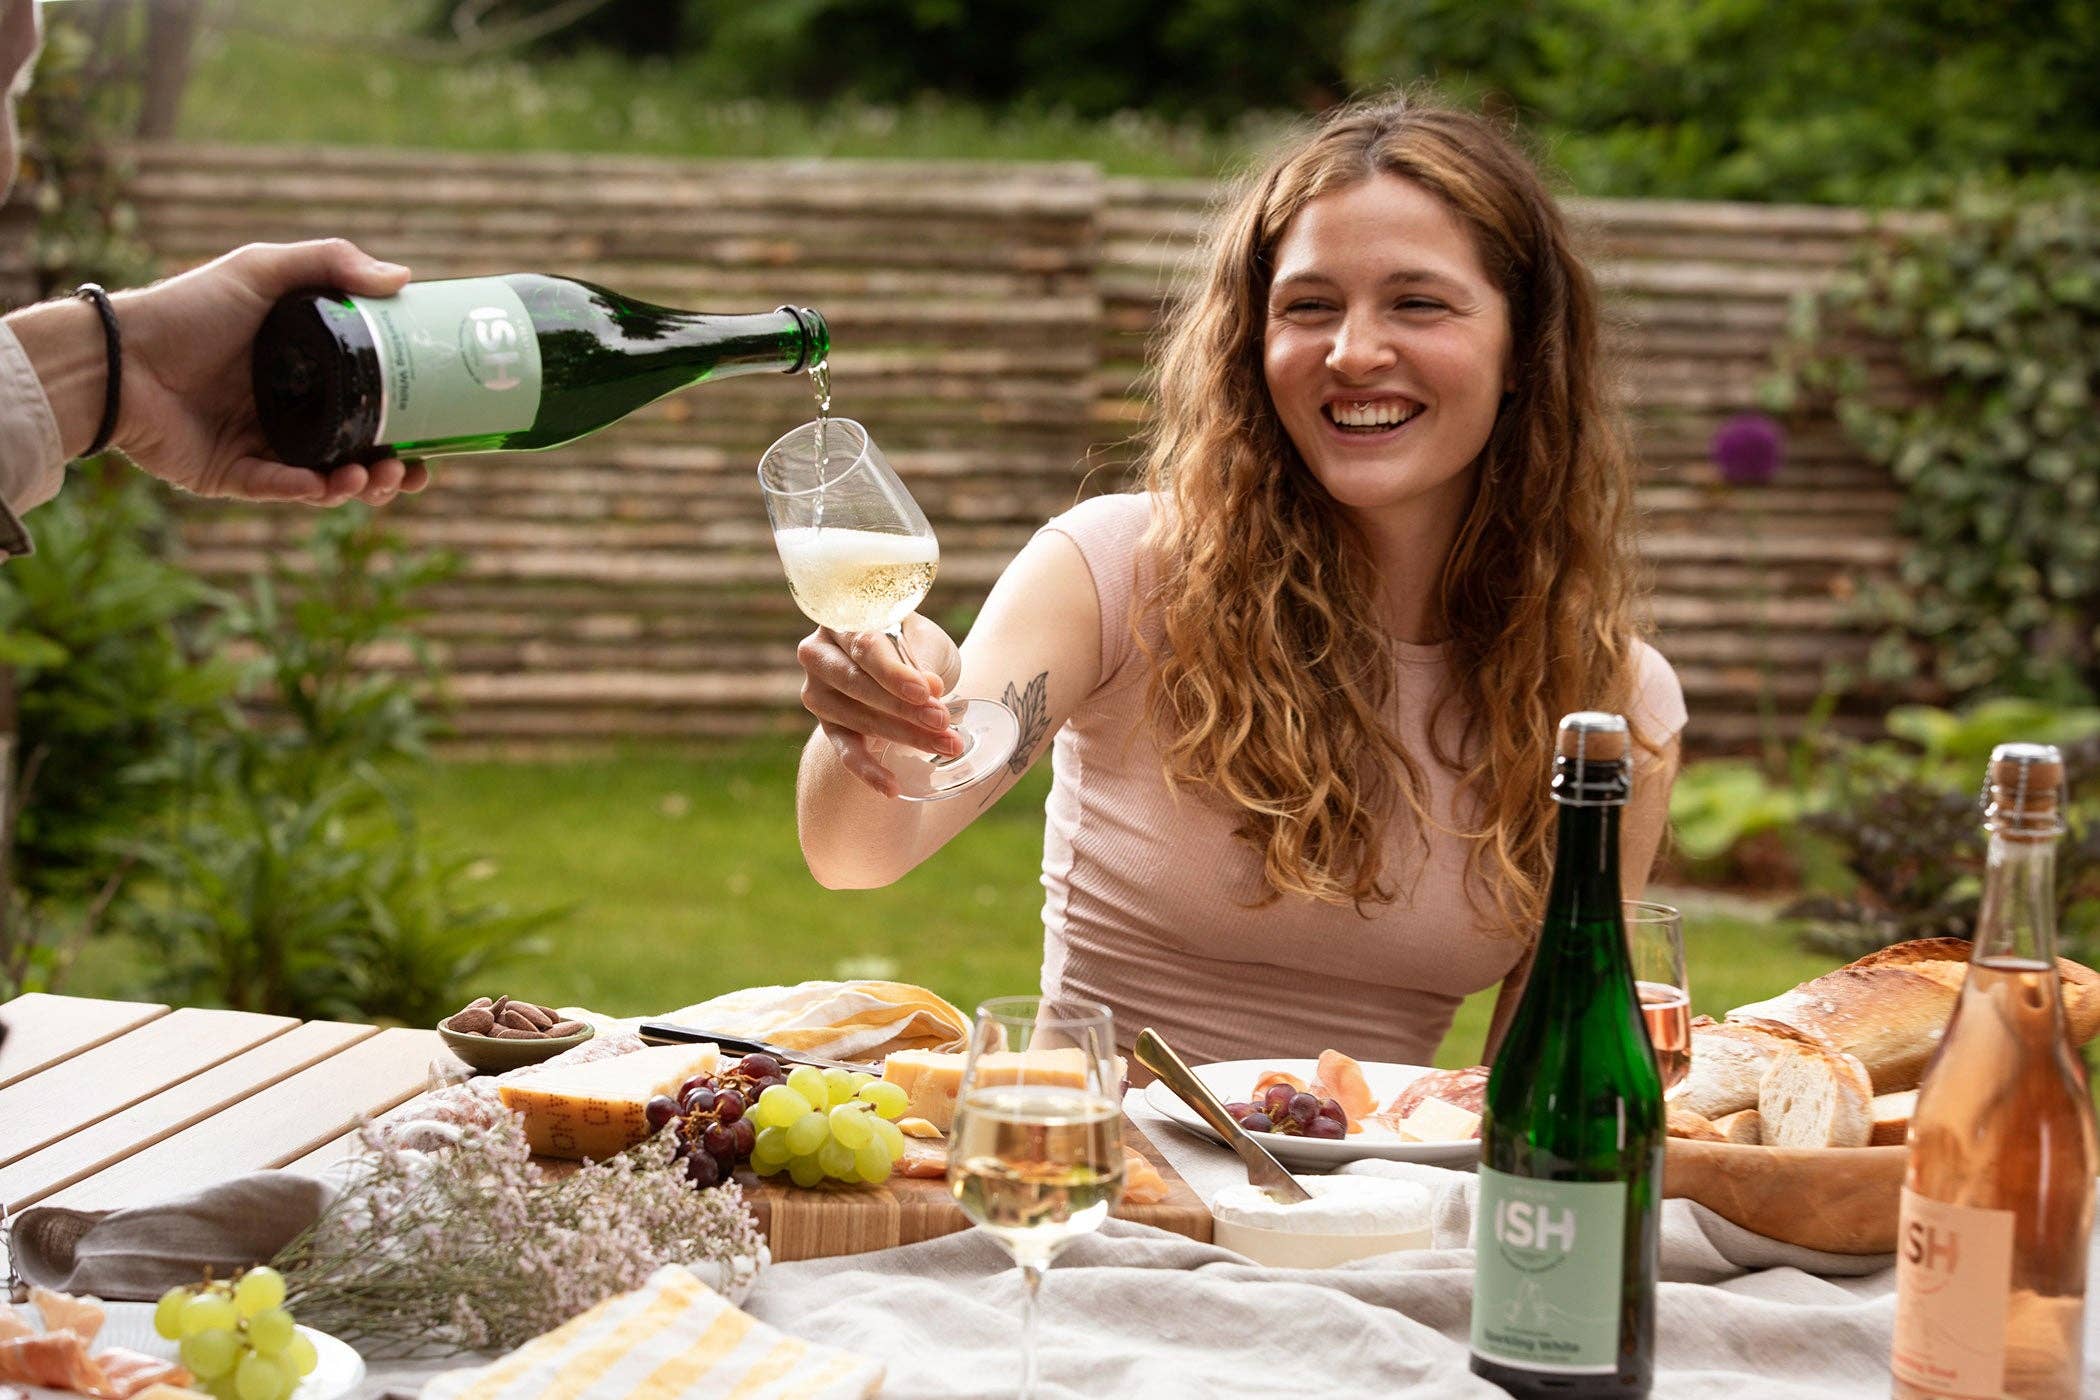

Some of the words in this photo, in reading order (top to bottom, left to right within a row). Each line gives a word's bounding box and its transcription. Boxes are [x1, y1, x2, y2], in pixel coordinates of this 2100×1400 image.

[469, 306, 521, 391] ISH
[1494, 1199, 1577, 1252] ISH
[1907, 1221, 1959, 1275] SH
